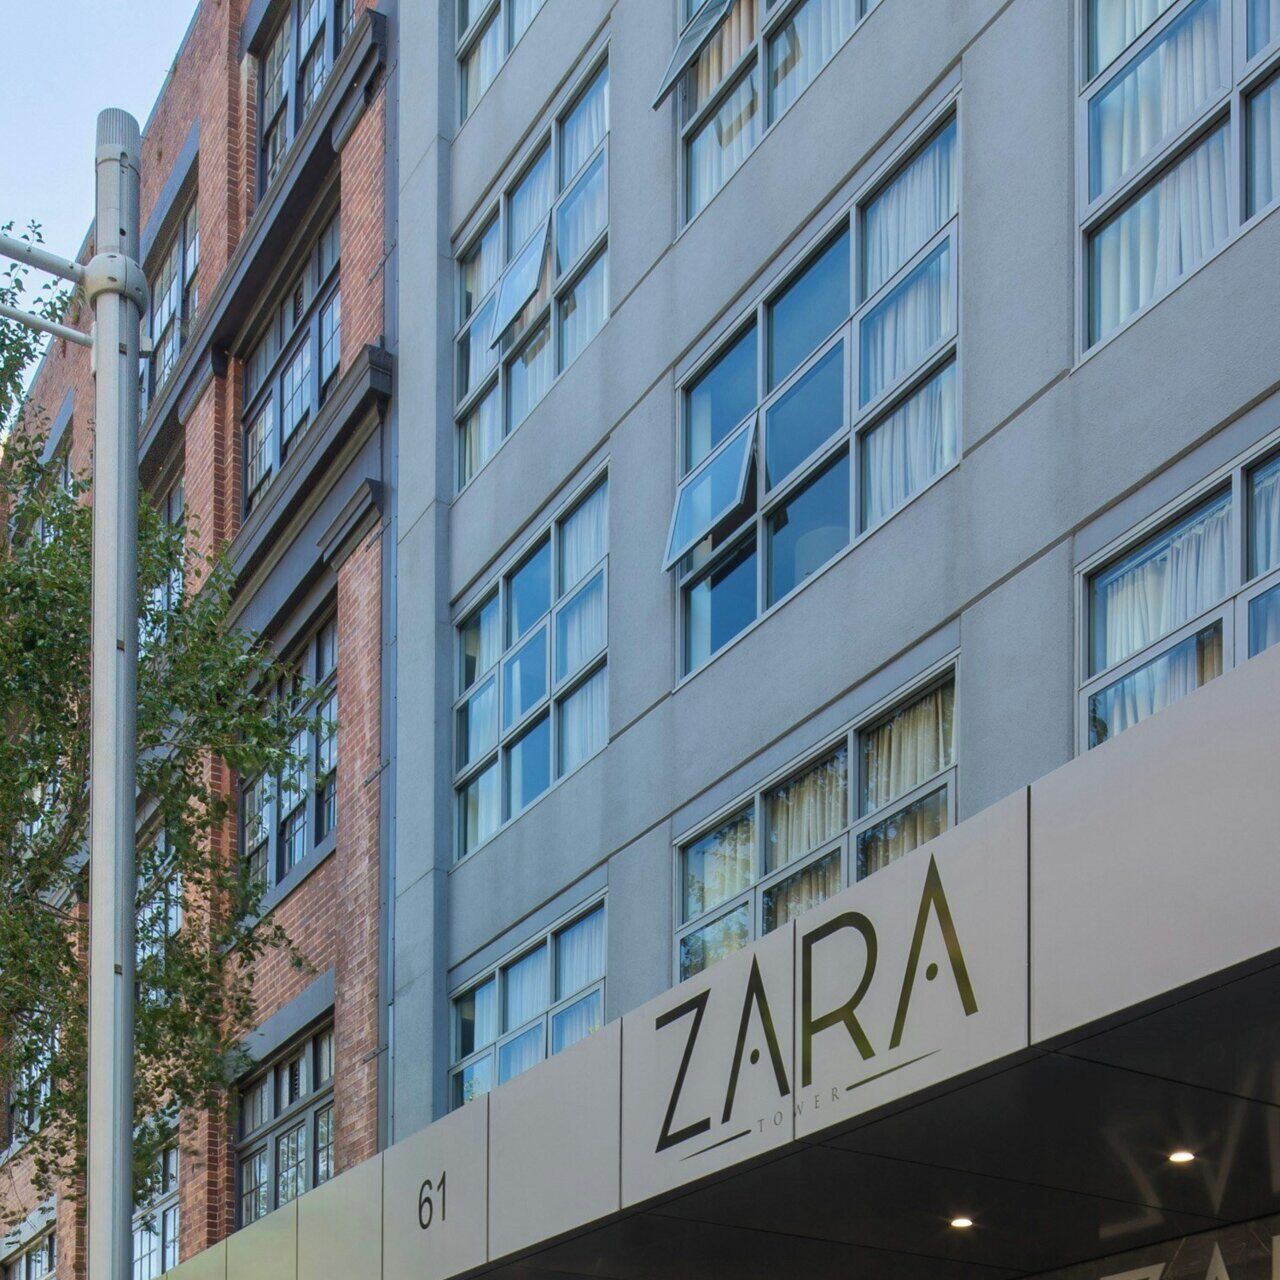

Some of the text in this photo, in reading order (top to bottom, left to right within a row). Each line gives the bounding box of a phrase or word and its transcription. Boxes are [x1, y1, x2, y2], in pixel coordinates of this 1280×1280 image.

[655, 853, 978, 1153] ZARA
[757, 1087, 840, 1132] TOWER
[418, 1171, 446, 1230] 61
